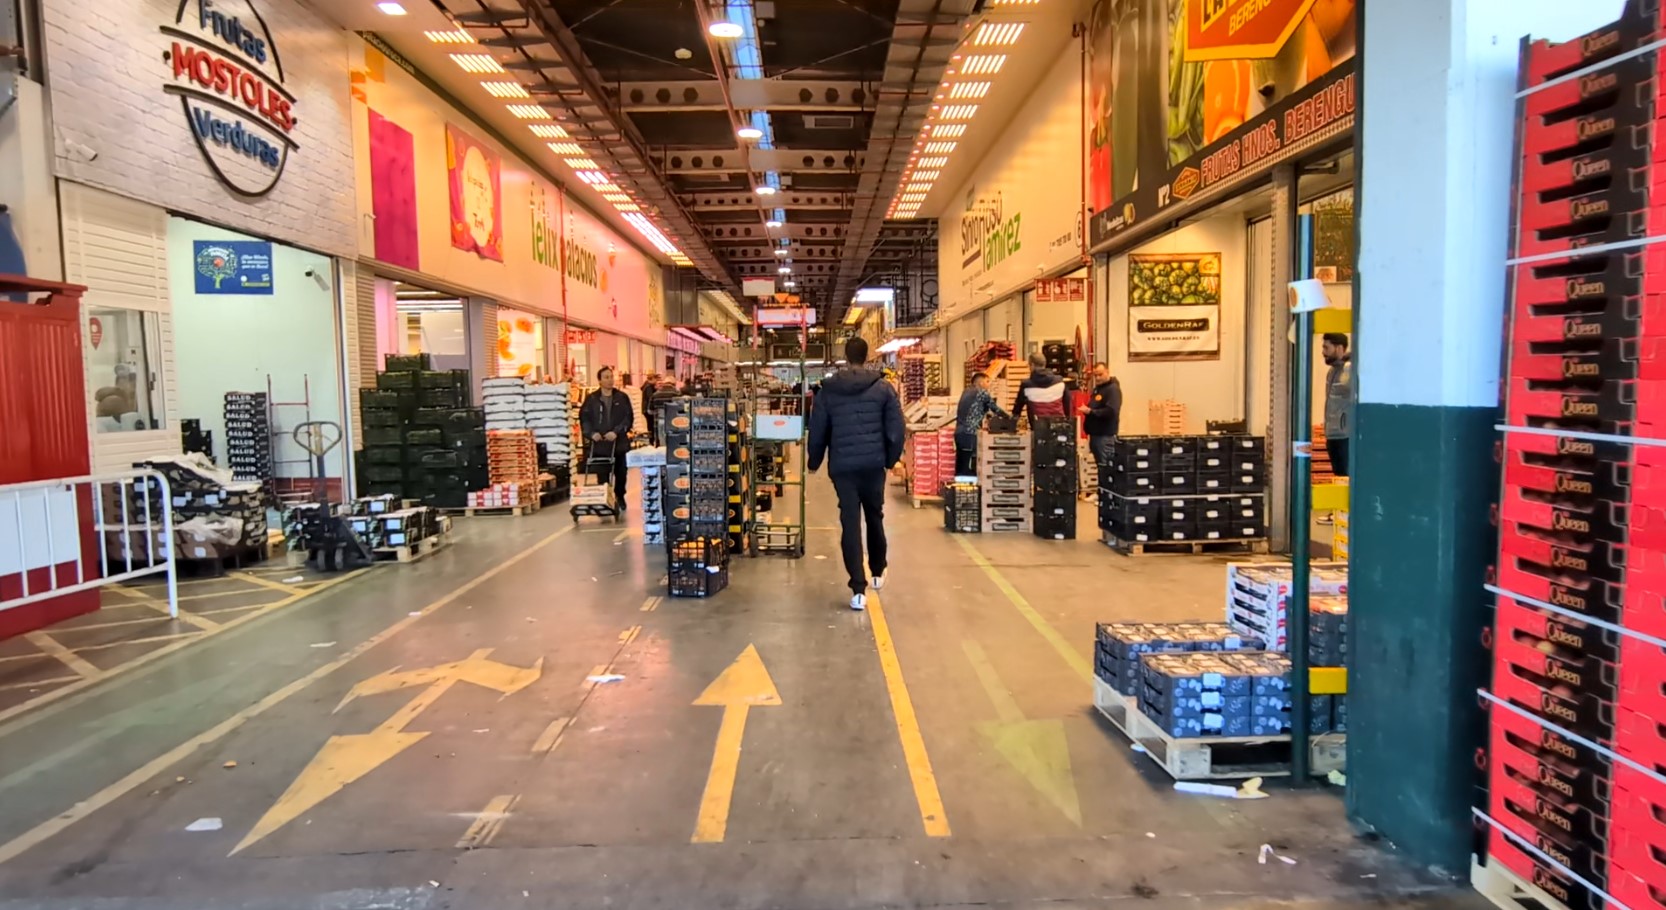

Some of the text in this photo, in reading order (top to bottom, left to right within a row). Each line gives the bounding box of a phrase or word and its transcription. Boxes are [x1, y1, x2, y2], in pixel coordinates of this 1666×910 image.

[199, 0, 265, 64] Frutas
[1583, 30, 1619, 57] Queen
[172, 42, 292, 133] MOSTOLES
[1581, 73, 1616, 97] Queen
[193, 107, 279, 170] Verduras
[1579, 118, 1615, 139] Queen
[1201, 140, 1240, 188] FRUTAS
[1241, 119, 1280, 166] HNOS.
[1573, 159, 1610, 179] Queen
[1572, 200, 1608, 219] Queen
[1568, 280, 1605, 298] Queen
[1565, 319, 1601, 338] Queen
[1563, 359, 1599, 377] Queen
[1563, 397, 1598, 415] Queen
[1558, 436, 1594, 454] Queen
[1556, 473, 1592, 493] Queen
[1553, 511, 1589, 533] Queen
[1552, 548, 1587, 570] Queen
[1551, 585, 1585, 610] Queen
[1548, 622, 1582, 647] Queen
[1547, 659, 1580, 686] Queen
[1542, 694, 1576, 722] Queen
[1542, 730, 1576, 759] Queen
[1539, 766, 1572, 797] Queen
[1537, 799, 1571, 831] Queen
[1534, 867, 1568, 901] Queen
